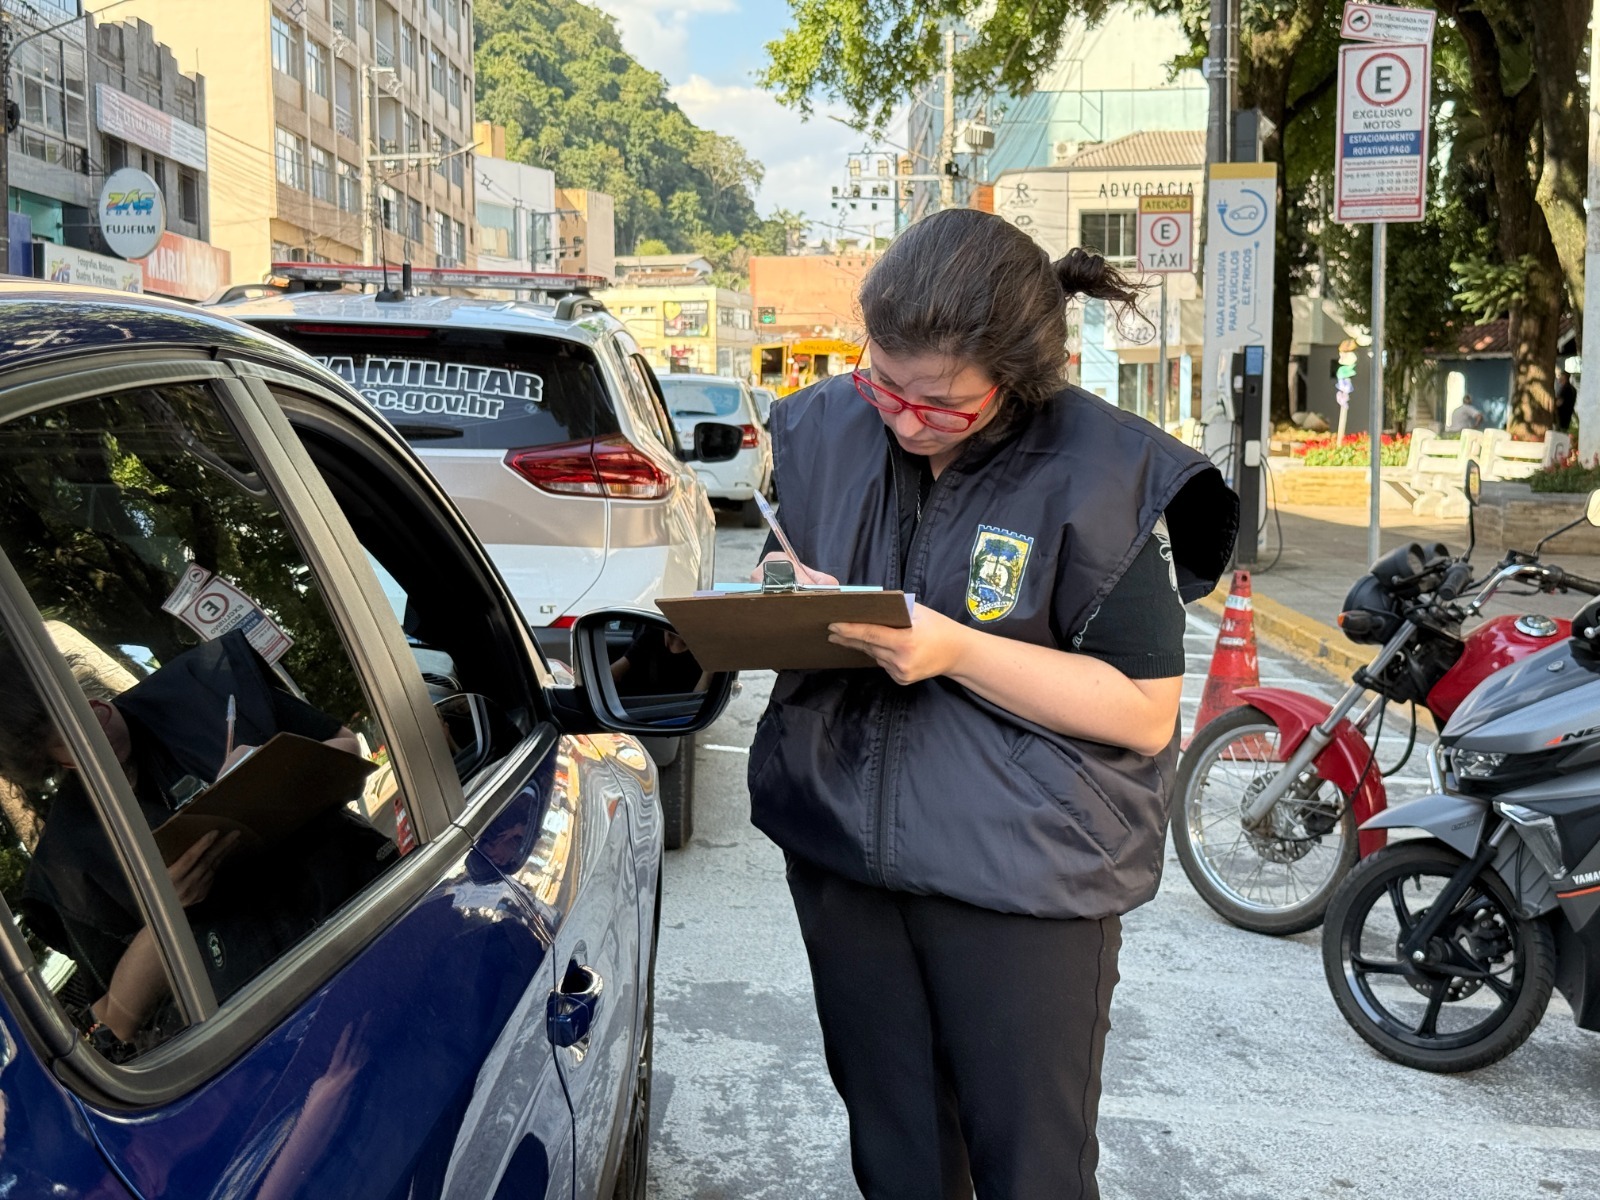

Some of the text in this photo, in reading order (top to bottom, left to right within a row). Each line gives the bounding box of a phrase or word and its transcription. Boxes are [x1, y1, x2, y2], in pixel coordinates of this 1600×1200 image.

[1375, 65, 1392, 94] E
[1352, 108, 1412, 120] EXCLUSIVO
[1363, 120, 1401, 130] MOTOS
[1348, 132, 1415, 144] ESTACIONAMENTO
[1352, 145, 1411, 156] ROTATIVO PAGO
[1099, 182, 1194, 198] ADVOCACIA
[1144, 198, 1188, 210] ATENÇÃO
[1160, 223, 1171, 240] E
[148, 246, 188, 285] MARIA
[1148, 249, 1183, 267] TÁXI
[1216, 250, 1226, 337] VAGA EXCLUSIVA
[1228, 303, 1237, 331] PARA
[364, 357, 544, 402] MILITAR
[360, 388, 504, 420] sc.gov.br
[540, 605, 557, 614] LT
[1571, 870, 1600, 885] YAMA
